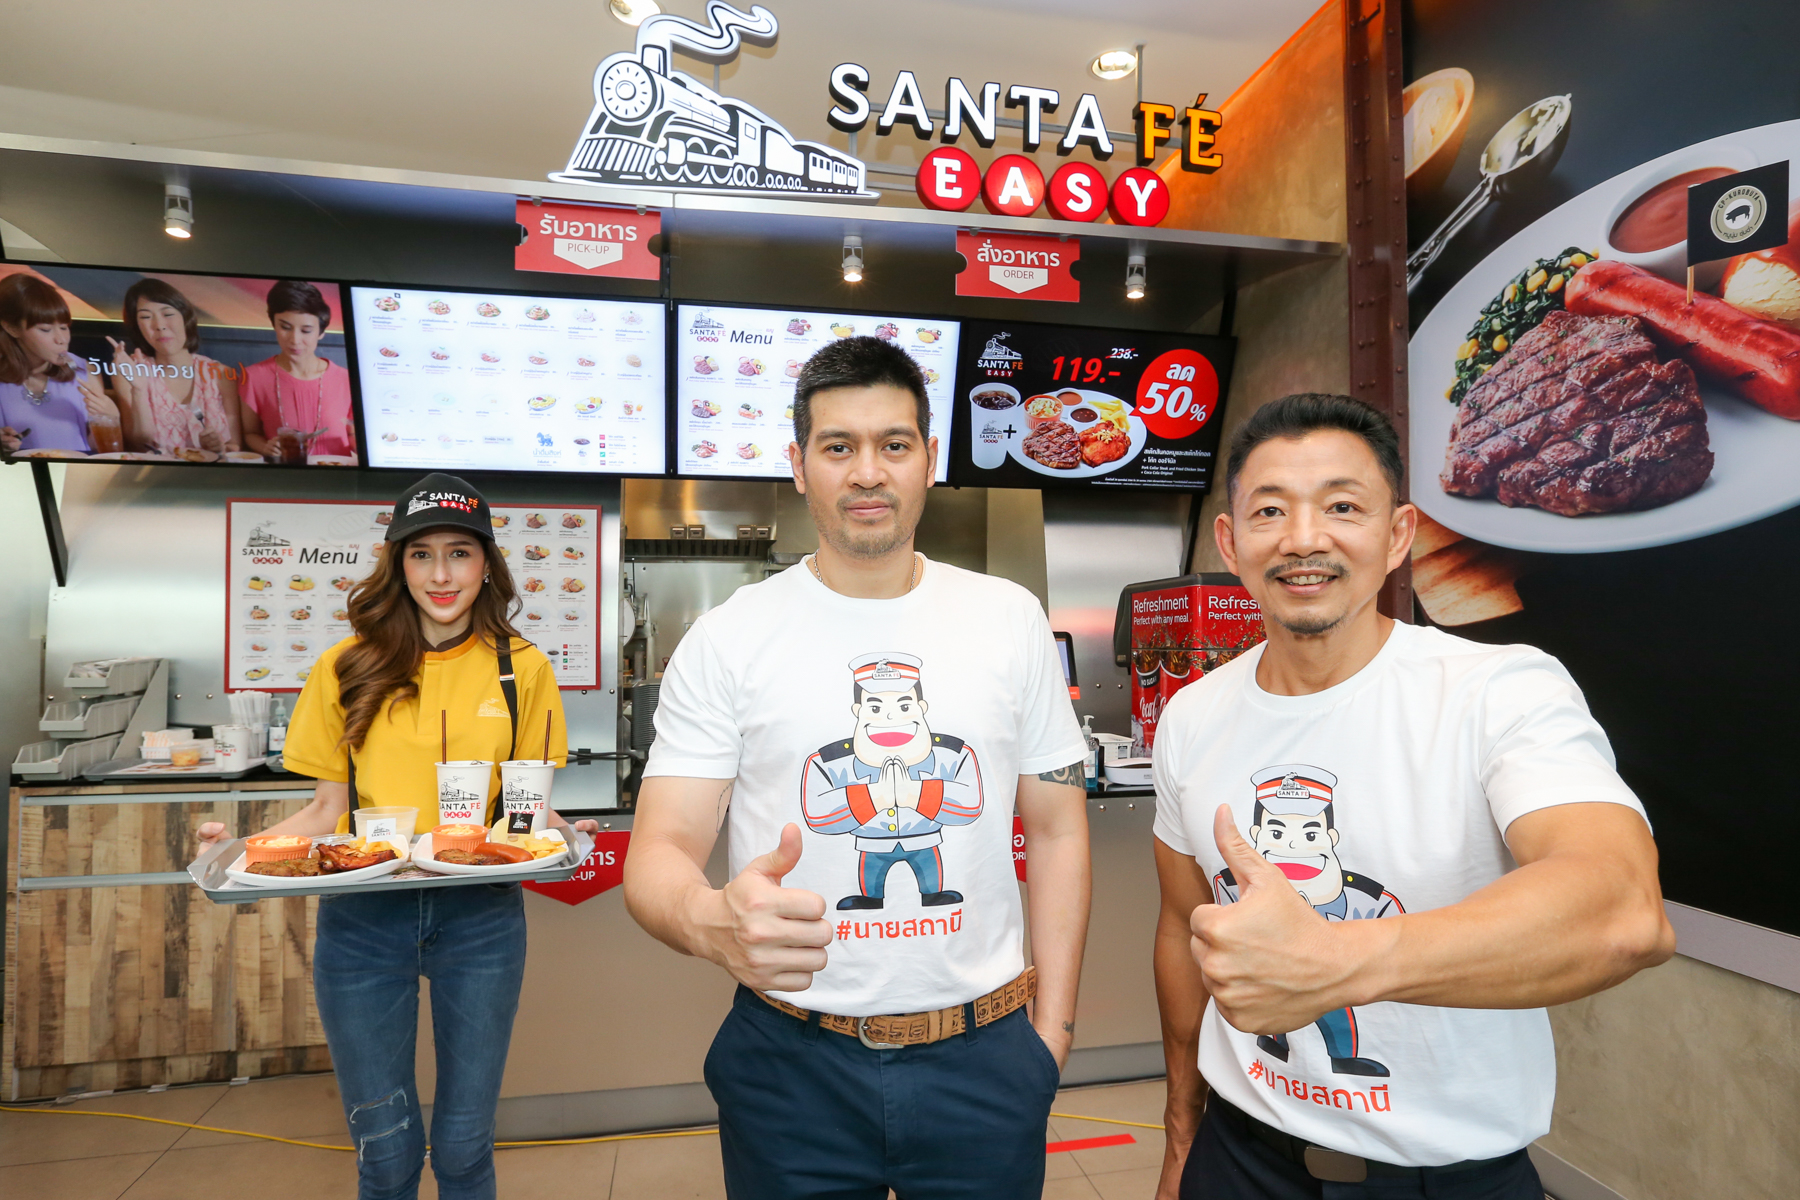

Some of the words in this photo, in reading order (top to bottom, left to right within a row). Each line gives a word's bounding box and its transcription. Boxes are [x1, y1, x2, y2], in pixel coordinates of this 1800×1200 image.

[827, 62, 1114, 160] SANTA
[1133, 92, 1223, 174] FÉ
[927, 153, 1163, 221] EASY
[1718, 188, 1761, 209] CP-KUROBUTA
[539, 213, 638, 242] รับอาหาร
[567, 242, 610, 255] PICK-UP
[976, 238, 1061, 268] สั่งอาหาร
[1003, 269, 1035, 280] ORDER
[689, 328, 716, 336] SANTA
[730, 329, 773, 345] Menu
[977, 359, 1010, 370] SANTA
[1052, 355, 1121, 384] 119.-
[1166, 363, 1196, 382] ลด
[1138, 381, 1207, 422] 50%
[429, 491, 467, 504] SANTA
[441, 501, 471, 512] EASY
[242, 548, 279, 557] SANTA
[252, 557, 283, 565] EASY
[299, 547, 358, 565] Menu
[1133, 594, 1189, 613] Refreshment
[1133, 614, 1151, 626] Perfect
[1151, 614, 1163, 625] with
[1162, 614, 1174, 625] any
[1208, 611, 1242, 621] Perfect
[1243, 612, 1263, 621] with
[444, 811, 472, 819] EASY
[836, 908, 963, 940] #นายสถานี
[1247, 1058, 1392, 1113] #นายสถานี
